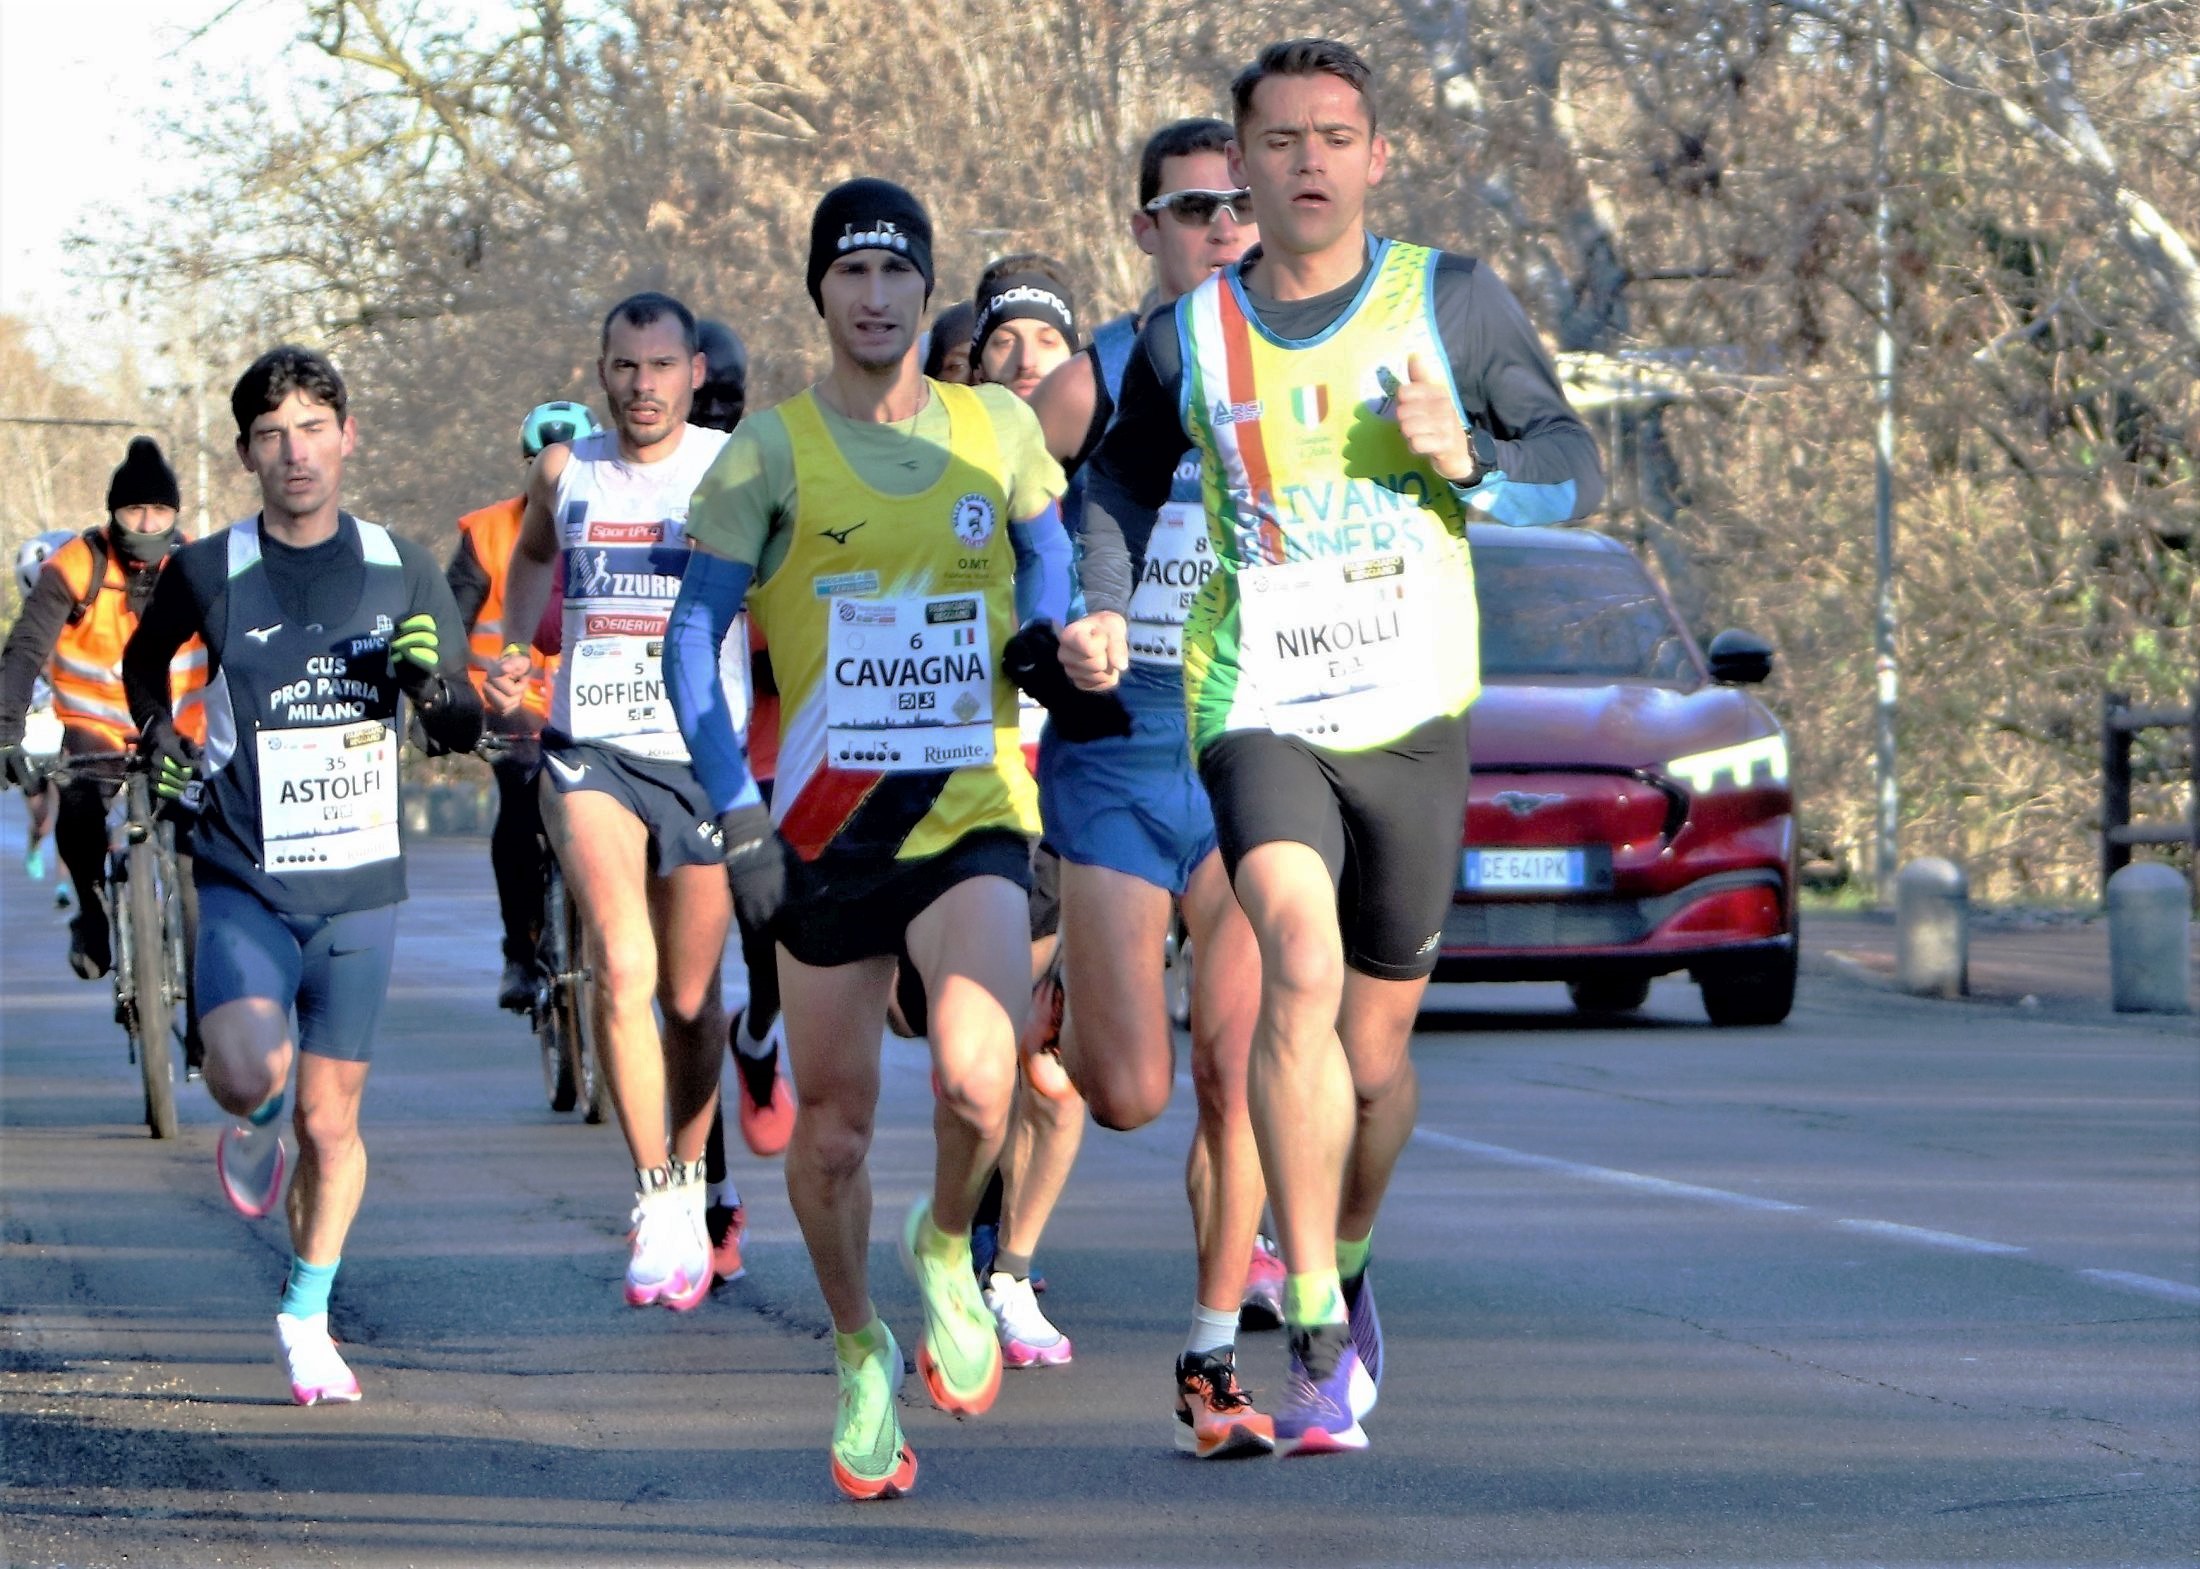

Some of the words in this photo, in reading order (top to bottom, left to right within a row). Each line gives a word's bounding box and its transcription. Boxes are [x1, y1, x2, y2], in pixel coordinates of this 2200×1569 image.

[1195, 537, 1207, 553] 8
[608, 620, 665, 631] ENERVIT
[910, 633, 923, 649] 6
[1275, 610, 1400, 660] NIKOLLI
[352, 637, 385, 655] pwc
[306, 657, 347, 675] CUS
[635, 662, 644, 675] 5
[835, 653, 985, 687] CAVAGNA
[270, 680, 311, 710] PRO
[317, 677, 379, 703] PATRIA
[287, 701, 366, 720] MILANO
[924, 744, 983, 763] Riunite
[325, 757, 346, 771] 35
[280, 770, 380, 804] ASTOLFI
